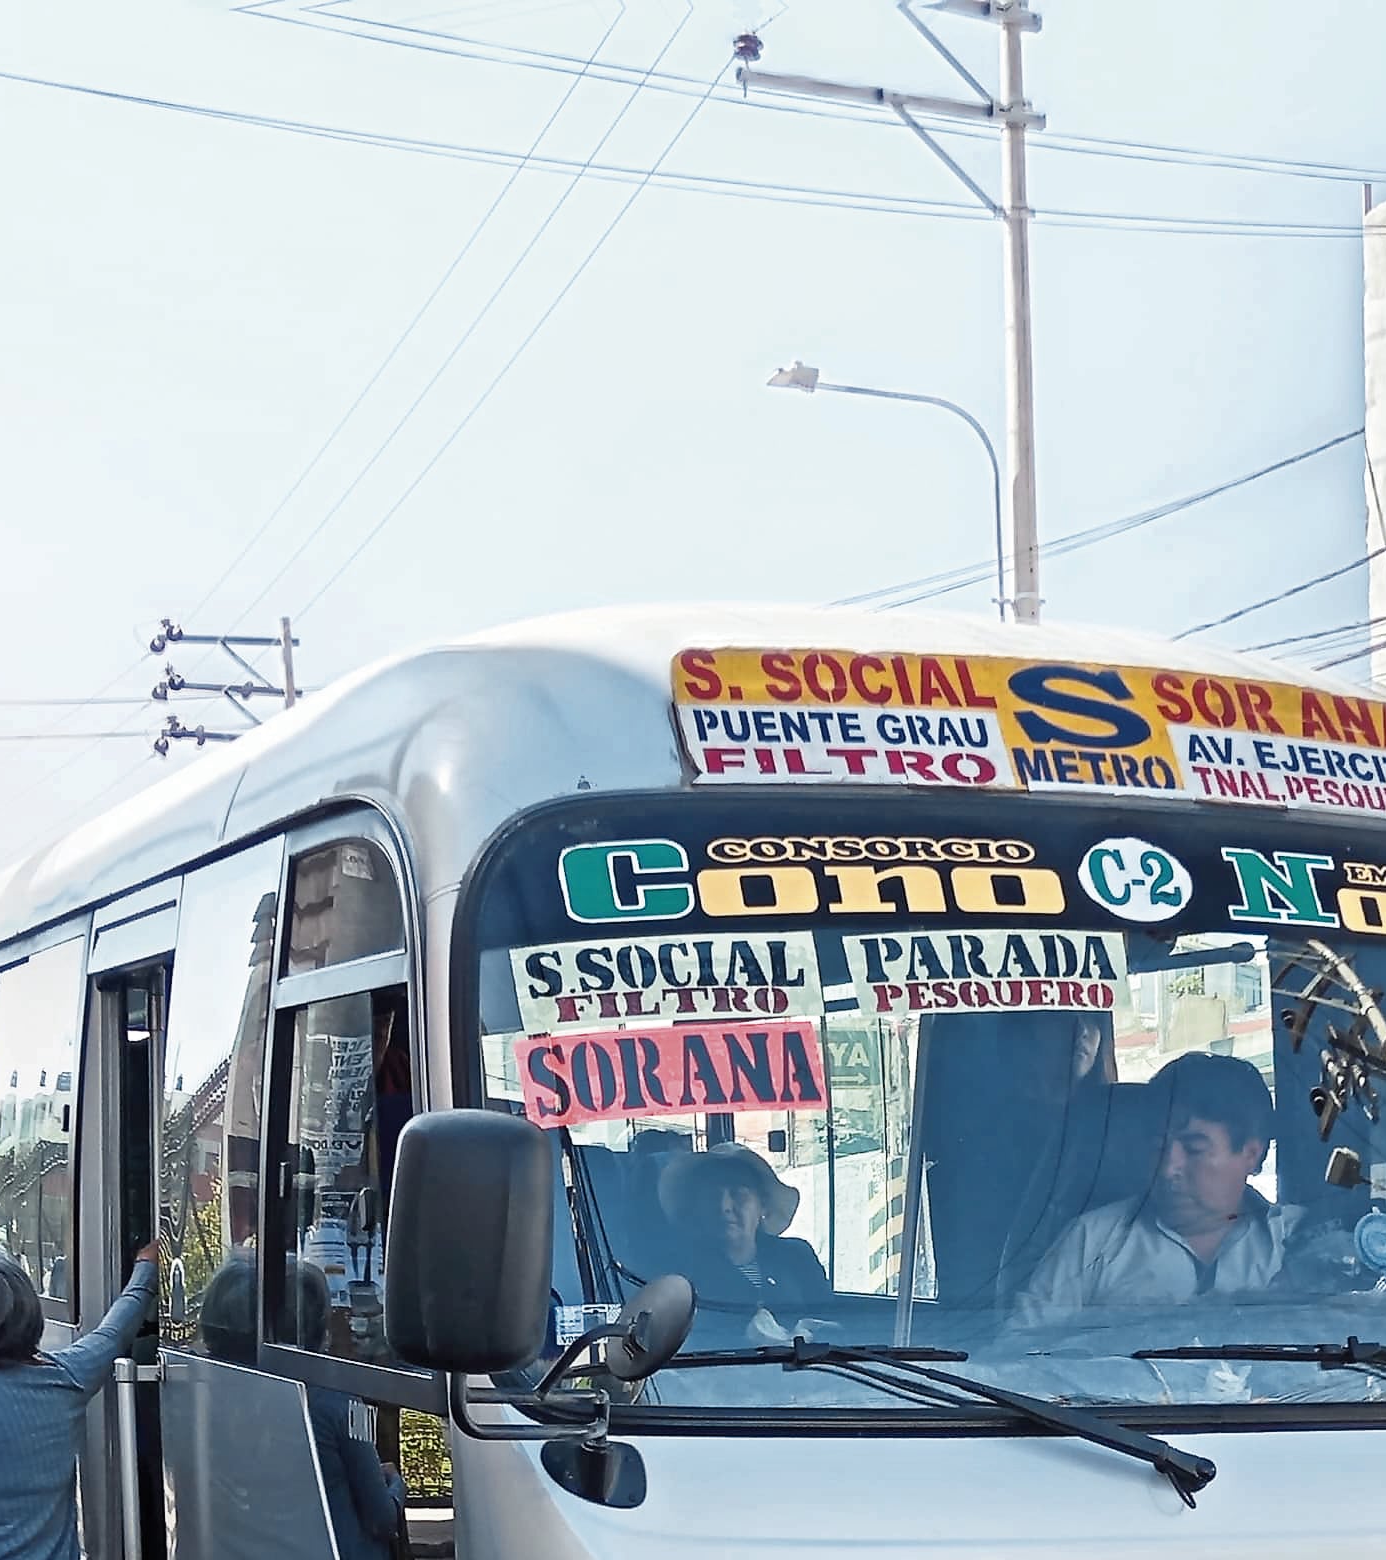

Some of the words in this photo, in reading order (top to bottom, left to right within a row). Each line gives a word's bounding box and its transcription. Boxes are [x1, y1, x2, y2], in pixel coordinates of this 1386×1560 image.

[680, 651, 744, 701] S.
[761, 653, 998, 709] SOCIAL
[1009, 664, 1151, 749] S
[1151, 673, 1286, 736] SOR
[693, 709, 869, 744] PUENTE
[876, 714, 989, 748] GRAU
[1189, 734, 1244, 766] AV.
[703, 748, 997, 785] FILTRO
[1012, 747, 1176, 790] METRO
[706, 836, 1036, 864] CONSORCIO
[558, 838, 1066, 924] Cono
[1088, 847, 1182, 907] C-2
[857, 935, 1119, 983] PARADA
[555, 986, 791, 1022] FILTRO
[872, 980, 1114, 1012] PESQUERO
